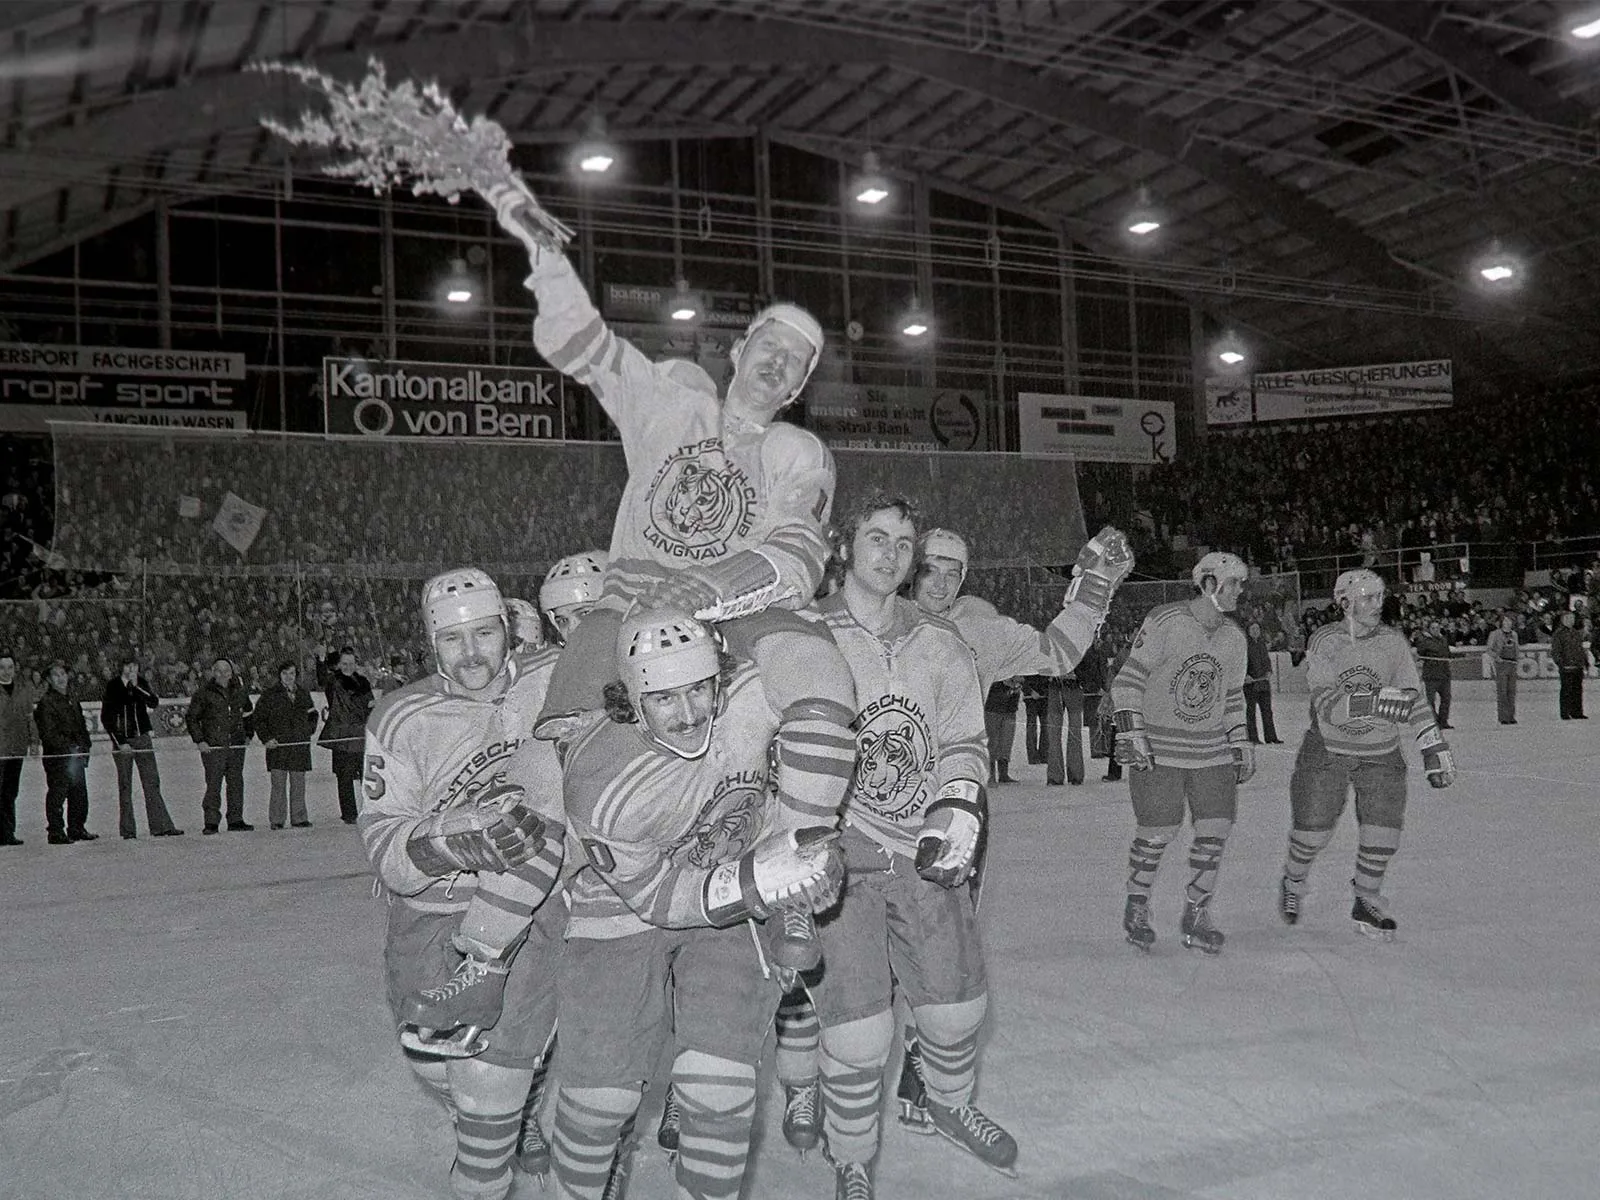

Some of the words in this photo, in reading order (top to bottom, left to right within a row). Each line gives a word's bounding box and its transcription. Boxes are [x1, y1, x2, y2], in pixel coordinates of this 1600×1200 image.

[330, 363, 556, 408] Kantonalbank
[1300, 363, 1450, 386] VERSICHERUNGEN
[3, 375, 103, 404] ropf
[116, 380, 233, 408] sport
[403, 409, 467, 436] von
[475, 404, 552, 437] Bern
[643, 526, 728, 560] LANGNAU
